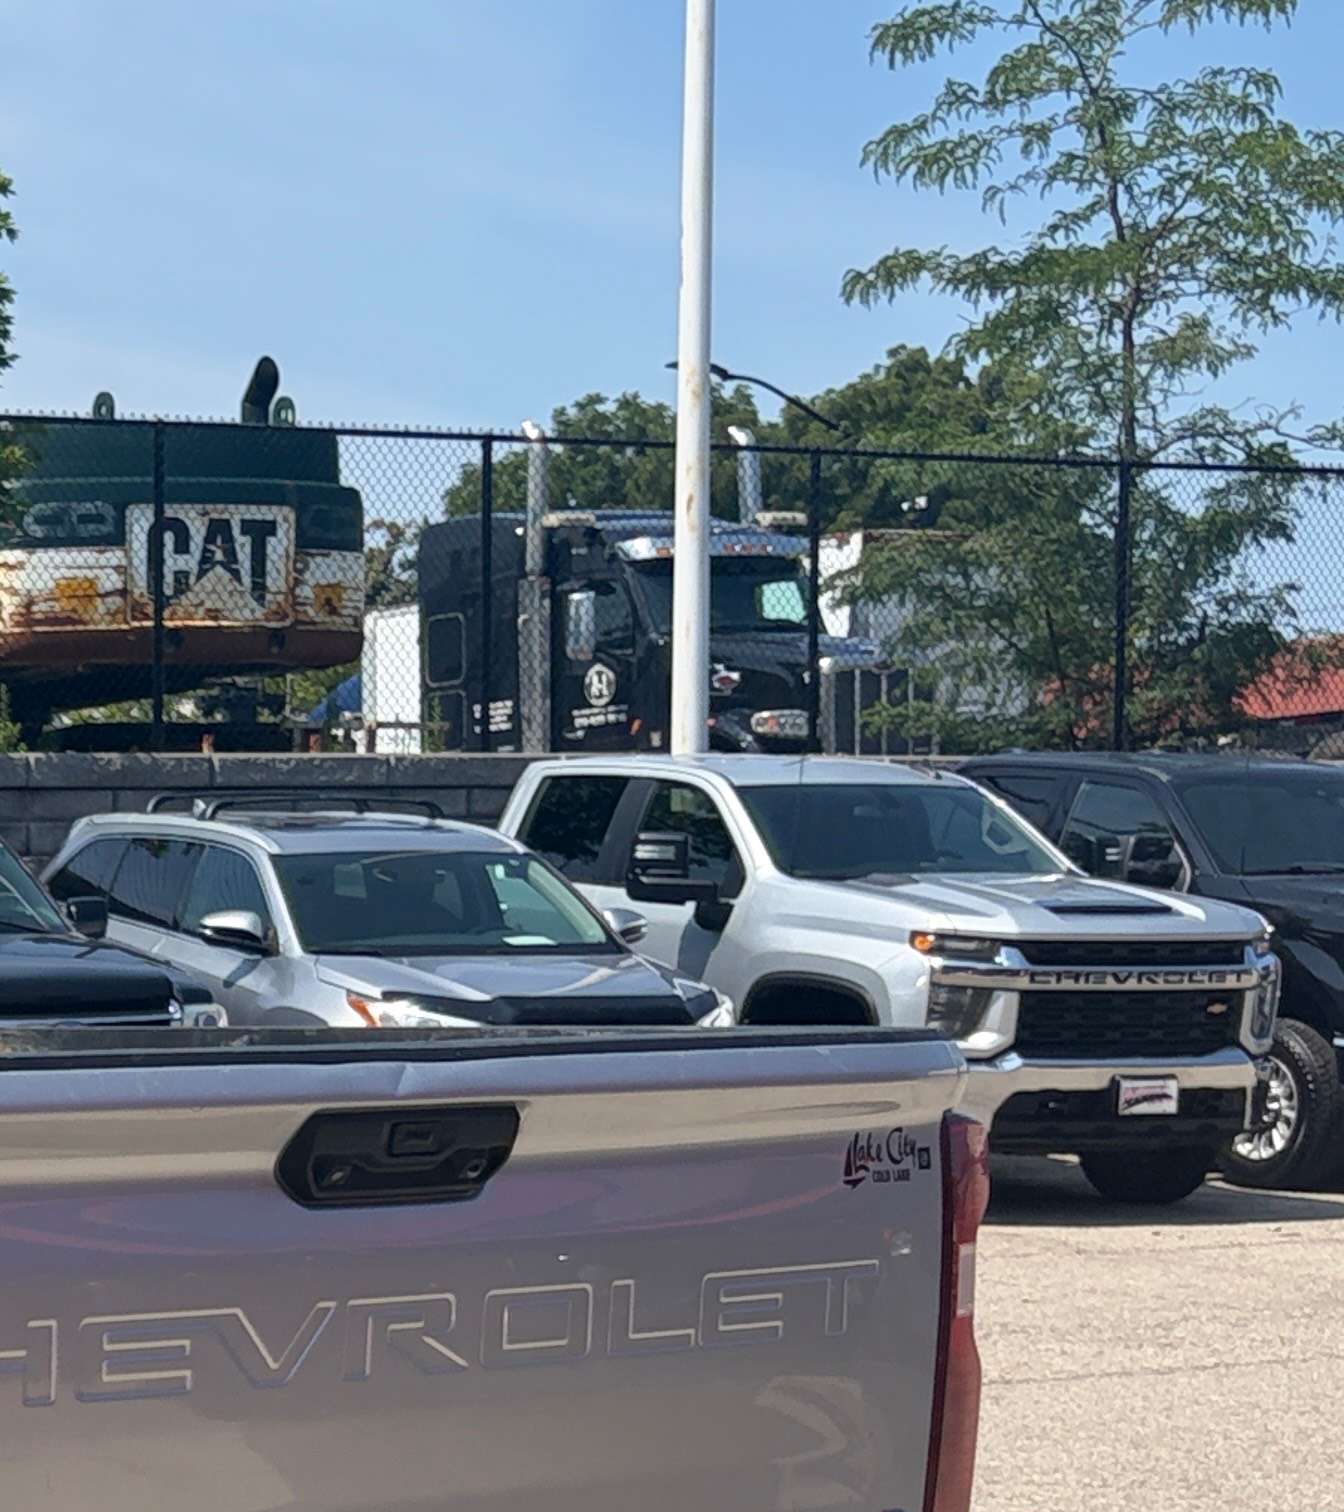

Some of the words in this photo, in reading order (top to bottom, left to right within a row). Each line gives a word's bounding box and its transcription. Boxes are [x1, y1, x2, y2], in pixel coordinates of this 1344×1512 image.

[147, 517, 277, 609] CAT
[1028, 969, 1252, 986] CHEVROLET
[886, 1127, 917, 1169] City
